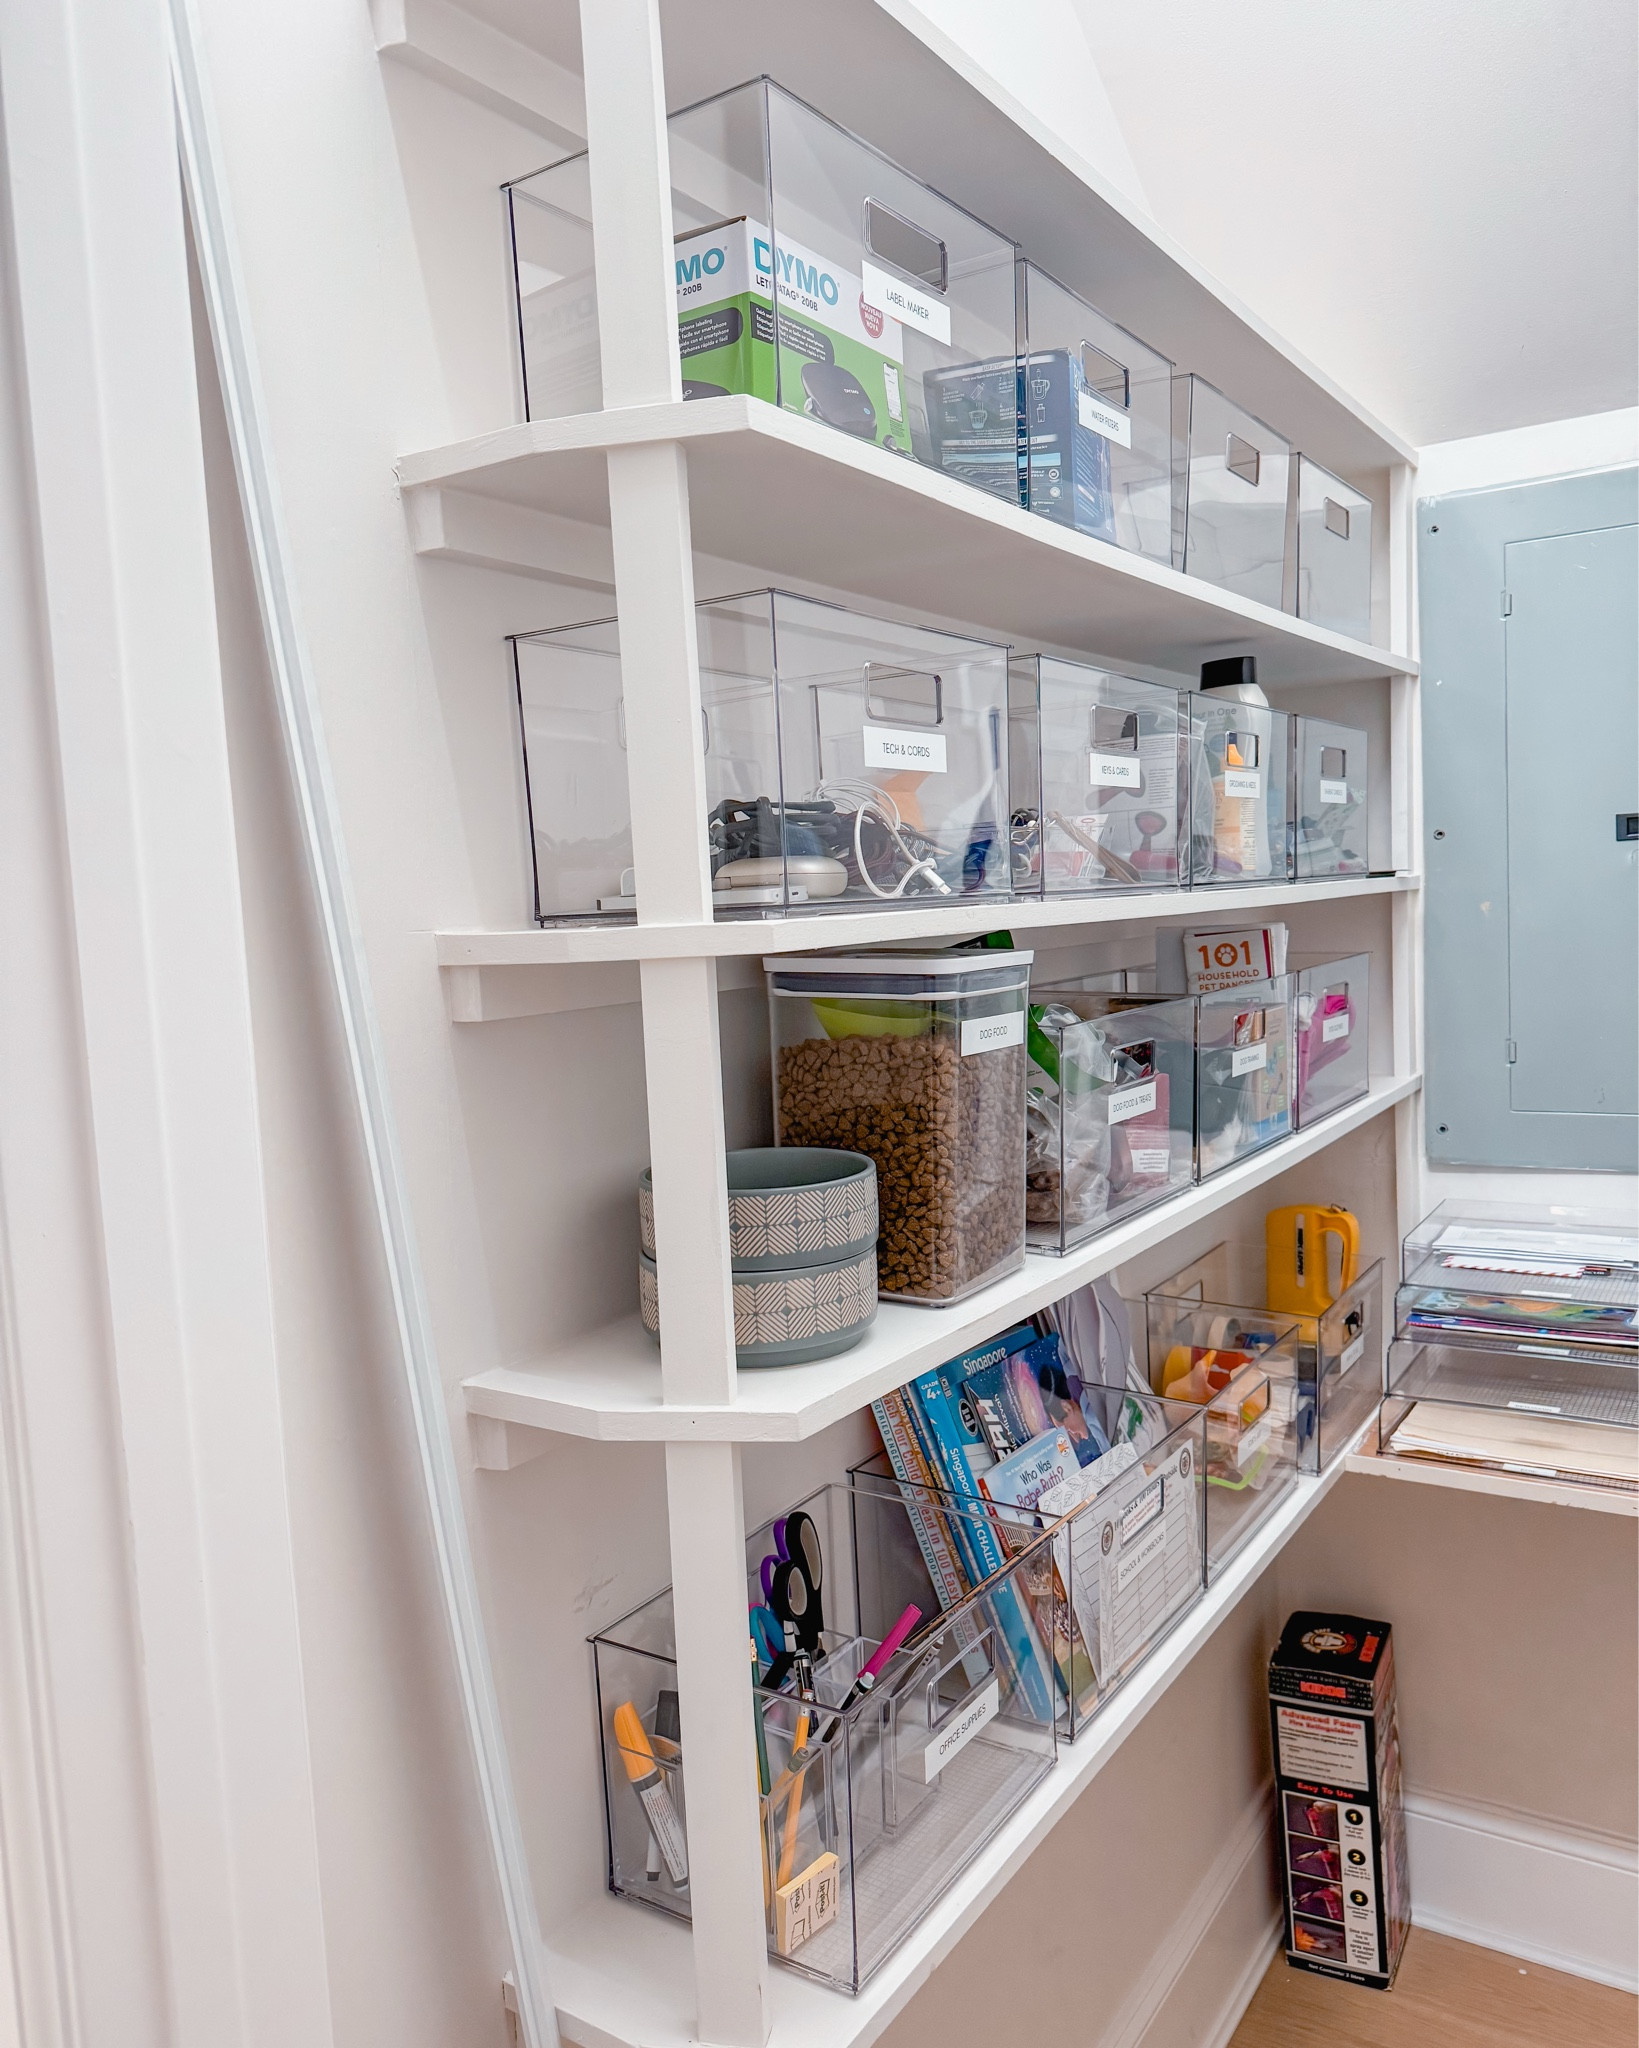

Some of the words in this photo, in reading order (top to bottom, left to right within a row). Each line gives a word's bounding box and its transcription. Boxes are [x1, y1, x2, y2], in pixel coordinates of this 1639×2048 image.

[676, 247, 725, 285] MO
[754, 237, 839, 306] DYMO
[683, 283, 702, 296] 200B
[801, 296, 818, 312] 200B
[886, 289, 906, 308] LABEL
[907, 301, 929, 320] MAKER
[1092, 410, 1104, 423] WATER
[1105, 417, 1119, 431] FILTERS
[1217, 708, 1237, 717] One
[883, 743, 899, 754] TECH
[901, 745, 905, 755] &
[907, 746, 930, 757] CORDS
[1102, 765, 1111, 775] KEYS
[1116, 767, 1129, 776] CARDS
[1198, 941, 1251, 969] 101
[1198, 969, 1260, 981] HOUSEHOLD
[1199, 983, 1217, 991] PET
[980, 1029, 992, 1040] DOG
[993, 1026, 1008, 1037] FOOD
[1113, 1102, 1123, 1113] DOG
[1124, 1098, 1135, 1109] FOOD
[1138, 1093, 1151, 1104] TREATS
[962, 1347, 1008, 1376] Singapore
[921, 1380, 939, 1390] GRADE
[927, 1388, 941, 1400] 4+
[893, 1392, 911, 1423] Jacob's
[905, 1423, 922, 1454] Ladder
[948, 1544, 961, 1566] GRADE
[1019, 1470, 1038, 1486] Who
[1036, 1459, 1053, 1475] Was
[1016, 1488, 1042, 1509] Babe
[1040, 1465, 1066, 1495] Ruth?
[892, 1417, 908, 1448] Your
[901, 1449, 923, 1481] Child
[929, 1529, 940, 1545] in
[935, 1547, 950, 1569] 100
[944, 1572, 962, 1602] Easy
[909, 1504, 925, 1538] HYLLIS
[920, 1538, 940, 1577] HADDOX
[1281, 1709, 1330, 1724] Advanced
[1333, 1718, 1361, 1730] Foam
[1289, 1719, 1303, 1727] Fire
[1306, 1722, 1354, 1735] Extinguisher
[939, 1728, 960, 1756] OFFICE
[961, 1703, 986, 1735] SUPPLIES
[1297, 1782, 1318, 1794] Easy
[1321, 1786, 1333, 1795] To
[1336, 1790, 1354, 1799] Use
[1350, 1813, 1357, 1821] 1
[1352, 1853, 1360, 1862] 2
[1355, 1894, 1363, 1903] 3
